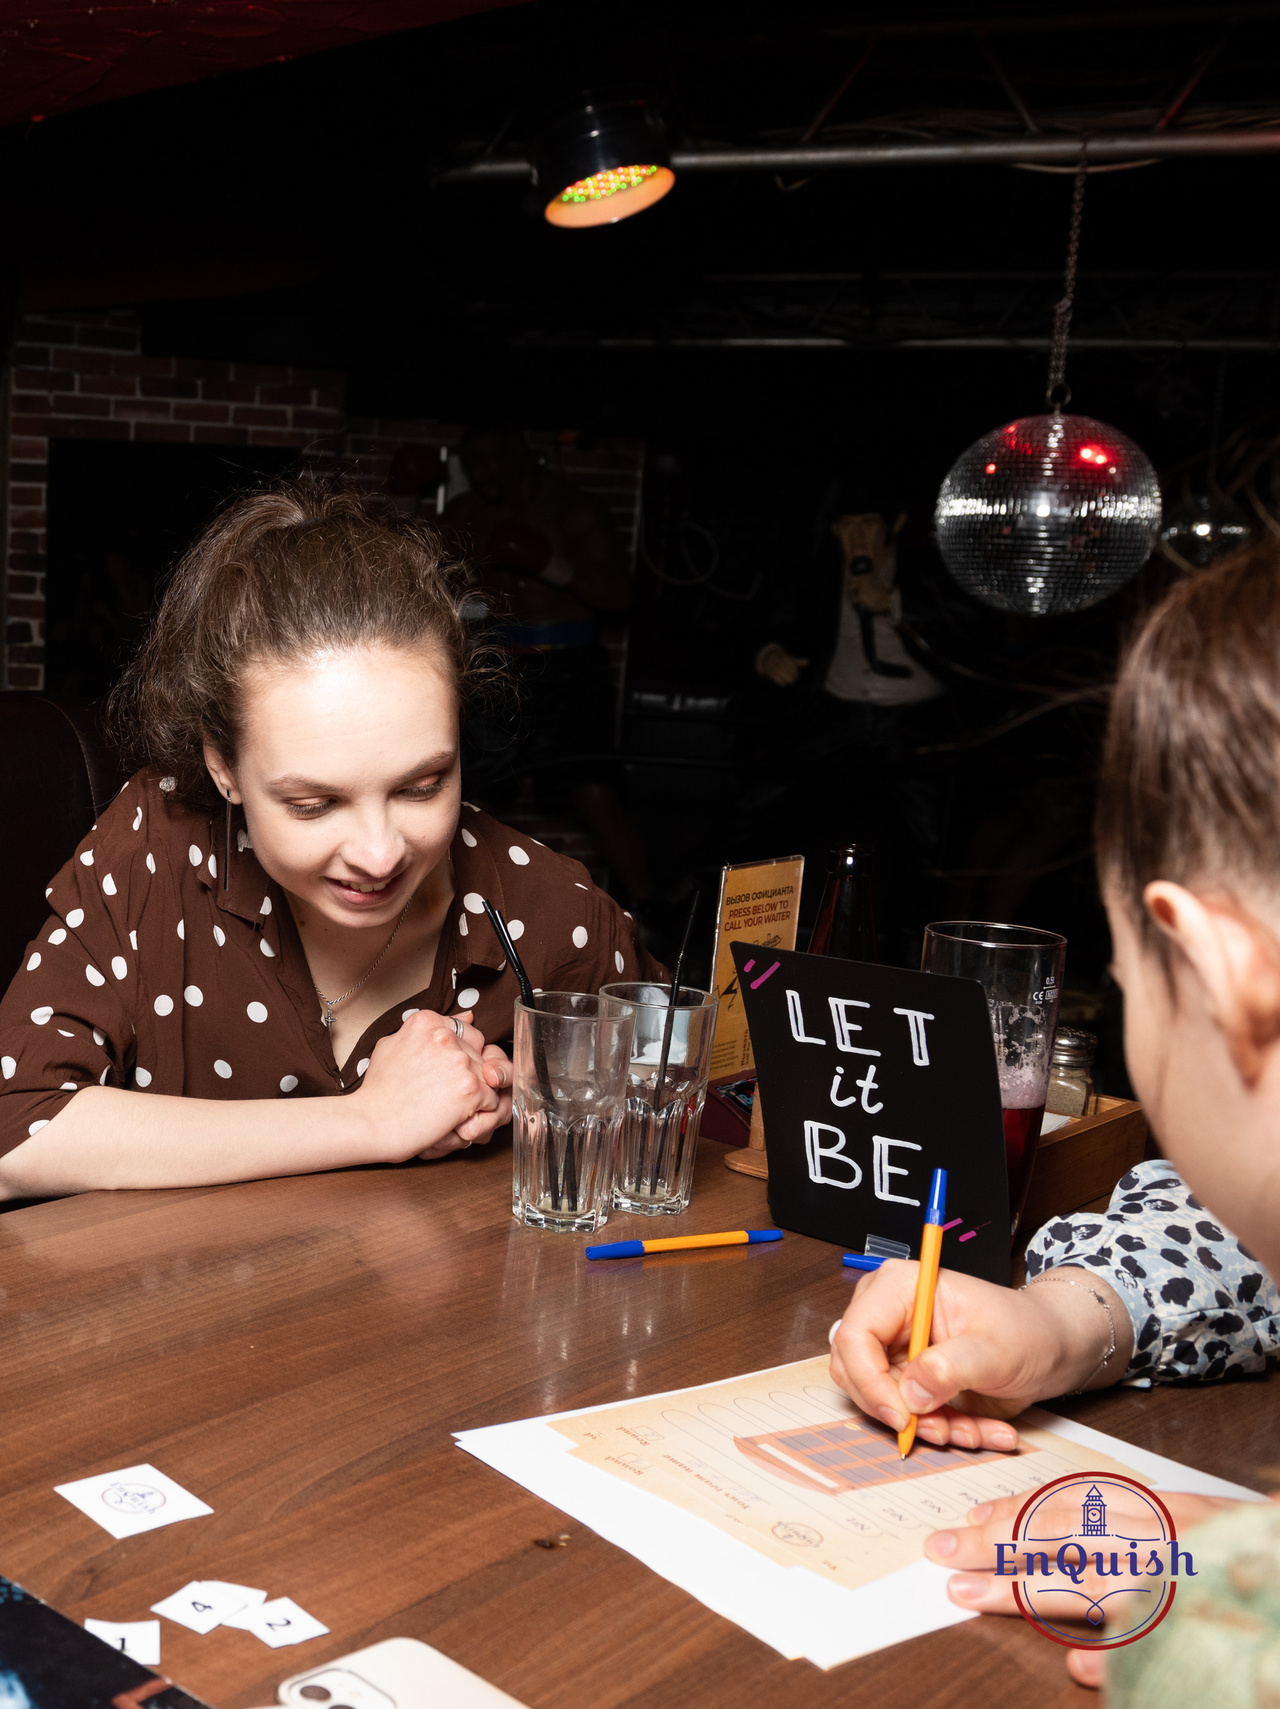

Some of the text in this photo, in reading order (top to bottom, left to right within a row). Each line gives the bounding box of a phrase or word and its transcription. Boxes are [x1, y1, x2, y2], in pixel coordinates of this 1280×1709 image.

[726, 886, 794, 905] ВЫЗОВ ОФИЦИАНТА
[729, 900, 789, 919] PRESS BELOW TO
[724, 911, 791, 932] CALL YOUR WAITER
[785, 989, 935, 1067] LET
[829, 1064, 884, 1114] it
[804, 1120, 923, 1207] BE
[616, 1425, 650, 1447] Round
[604, 1455, 645, 1476] Round
[663, 1454, 693, 1473] name
[694, 1473, 724, 1492] team
[724, 1492, 750, 1510] Your
[191, 1601, 214, 1613] 4
[265, 1617, 292, 1632] 2
[116, 1637, 127, 1654] 1
